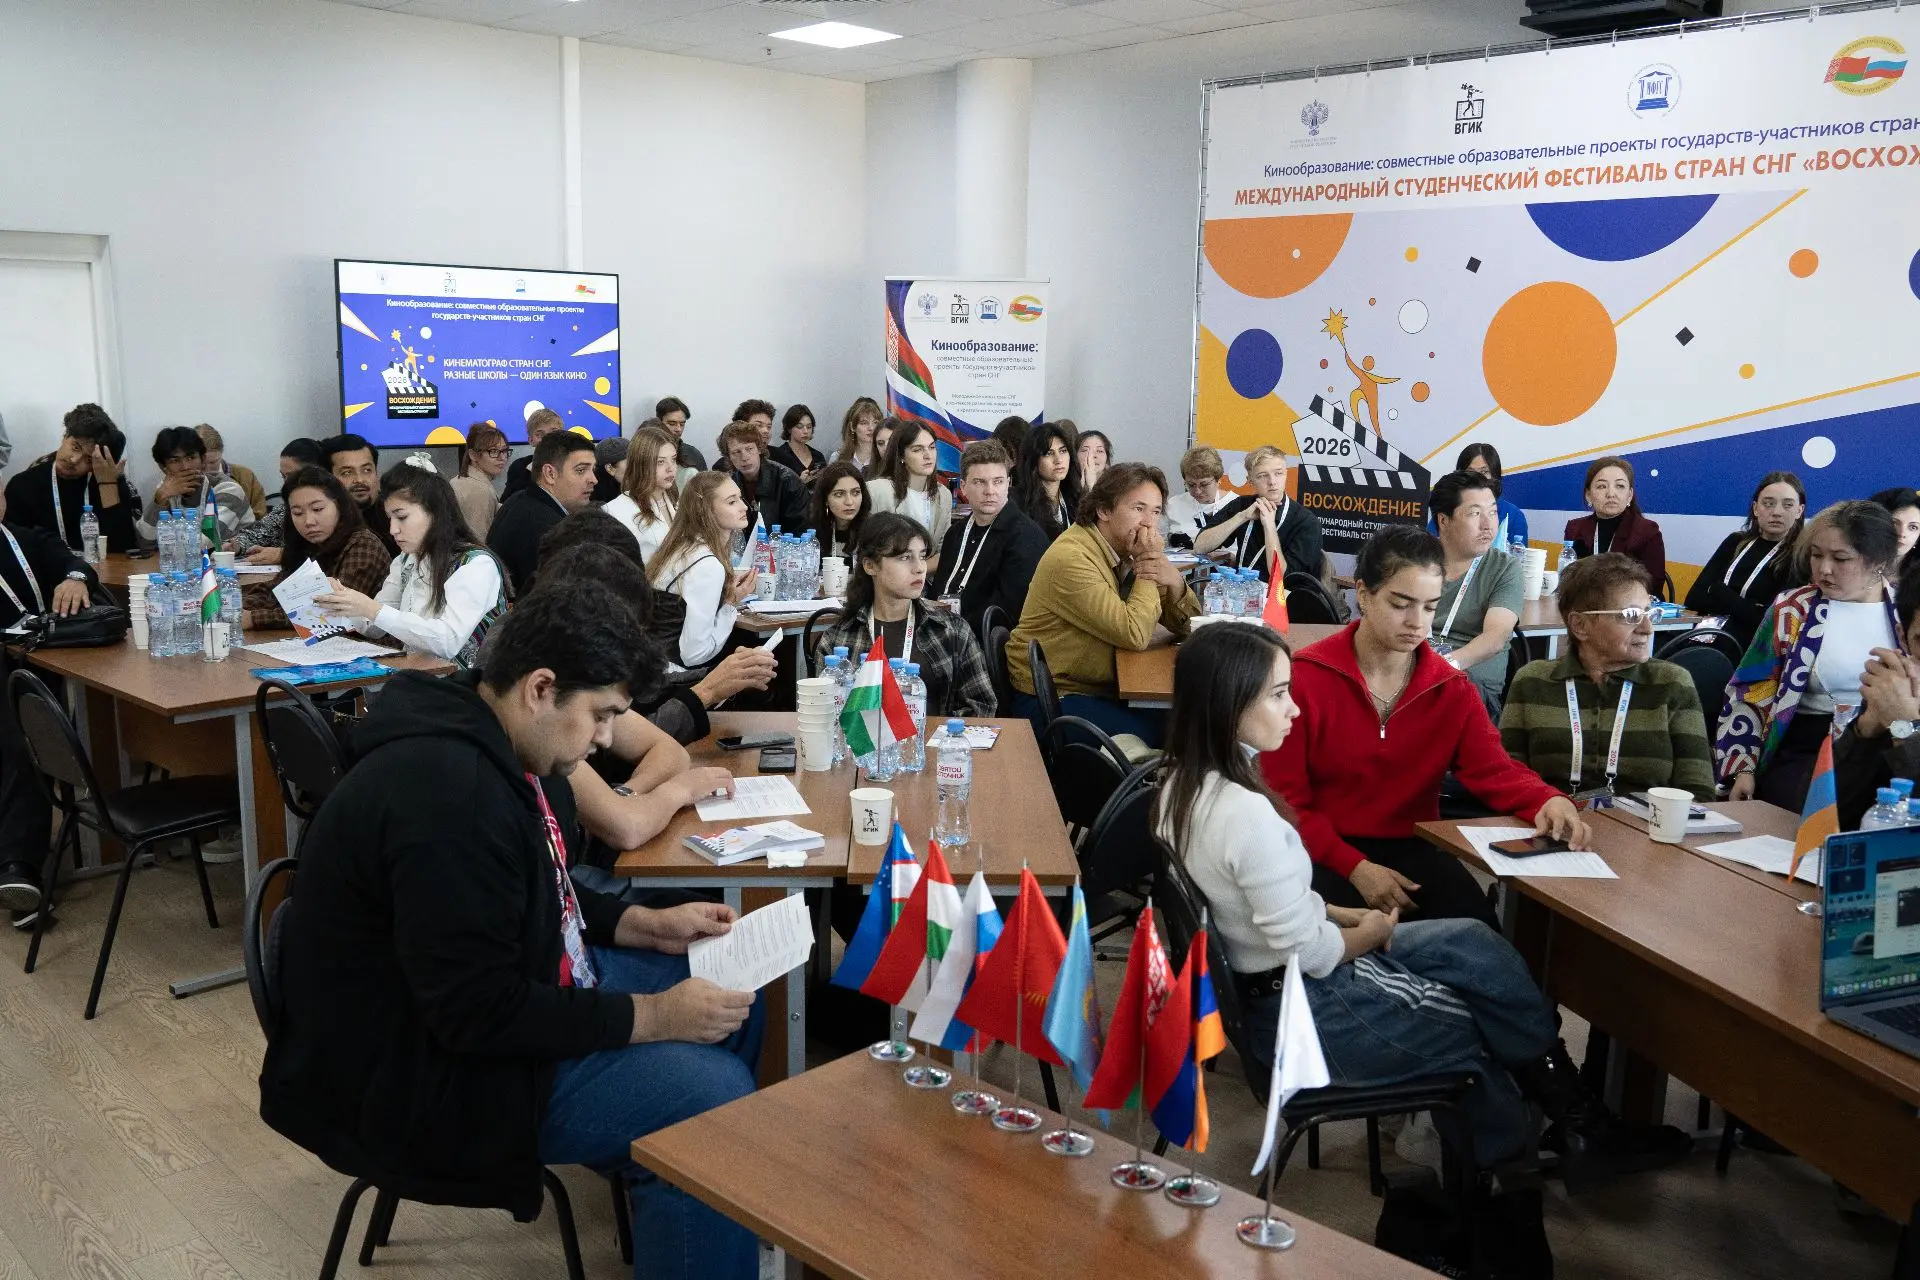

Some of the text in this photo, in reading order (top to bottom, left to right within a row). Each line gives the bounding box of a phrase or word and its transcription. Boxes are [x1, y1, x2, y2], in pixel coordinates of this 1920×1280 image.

[1454, 120, 1483, 134] ВГИК
[1264, 116, 1920, 178] Кинообразование: совместные образовательные проекты государств-участников стран
[1234, 176, 1389, 206] МЕЖДУНАРОДНЫЙ
[1394, 165, 1539, 197] СТУДЕНЧЕСКИЙ
[1544, 163, 1668, 187] ФЕСТИВАЛЬ
[1674, 156, 1745, 180] СТРАН
[1752, 152, 1796, 175] СНГ
[386, 298, 585, 314] Кинообразование: совместные образовательные проекты
[431, 312, 512, 321] государств-участников
[950, 316, 969, 324] ВГИК
[931, 339, 1039, 353] Кинообразование:
[443, 358, 552, 368] КИНЕМАТОГРАФ СТРАН СНГ:
[388, 376, 408, 384] 2026
[443, 371, 476, 379] РАЗНЫЕ
[477, 371, 508, 380] ШКОЛЫ
[519, 371, 543, 380] ОДИН
[543, 371, 565, 380] ЯЗЫК
[565, 371, 587, 380] КИНО
[388, 397, 437, 405] ВОСХОЖДЕНИЕ
[1303, 436, 1351, 456] 2026
[1303, 492, 1422, 518] ВОСХОЖДЕНИЕ
[1609, 750, 1617, 767] 2026
